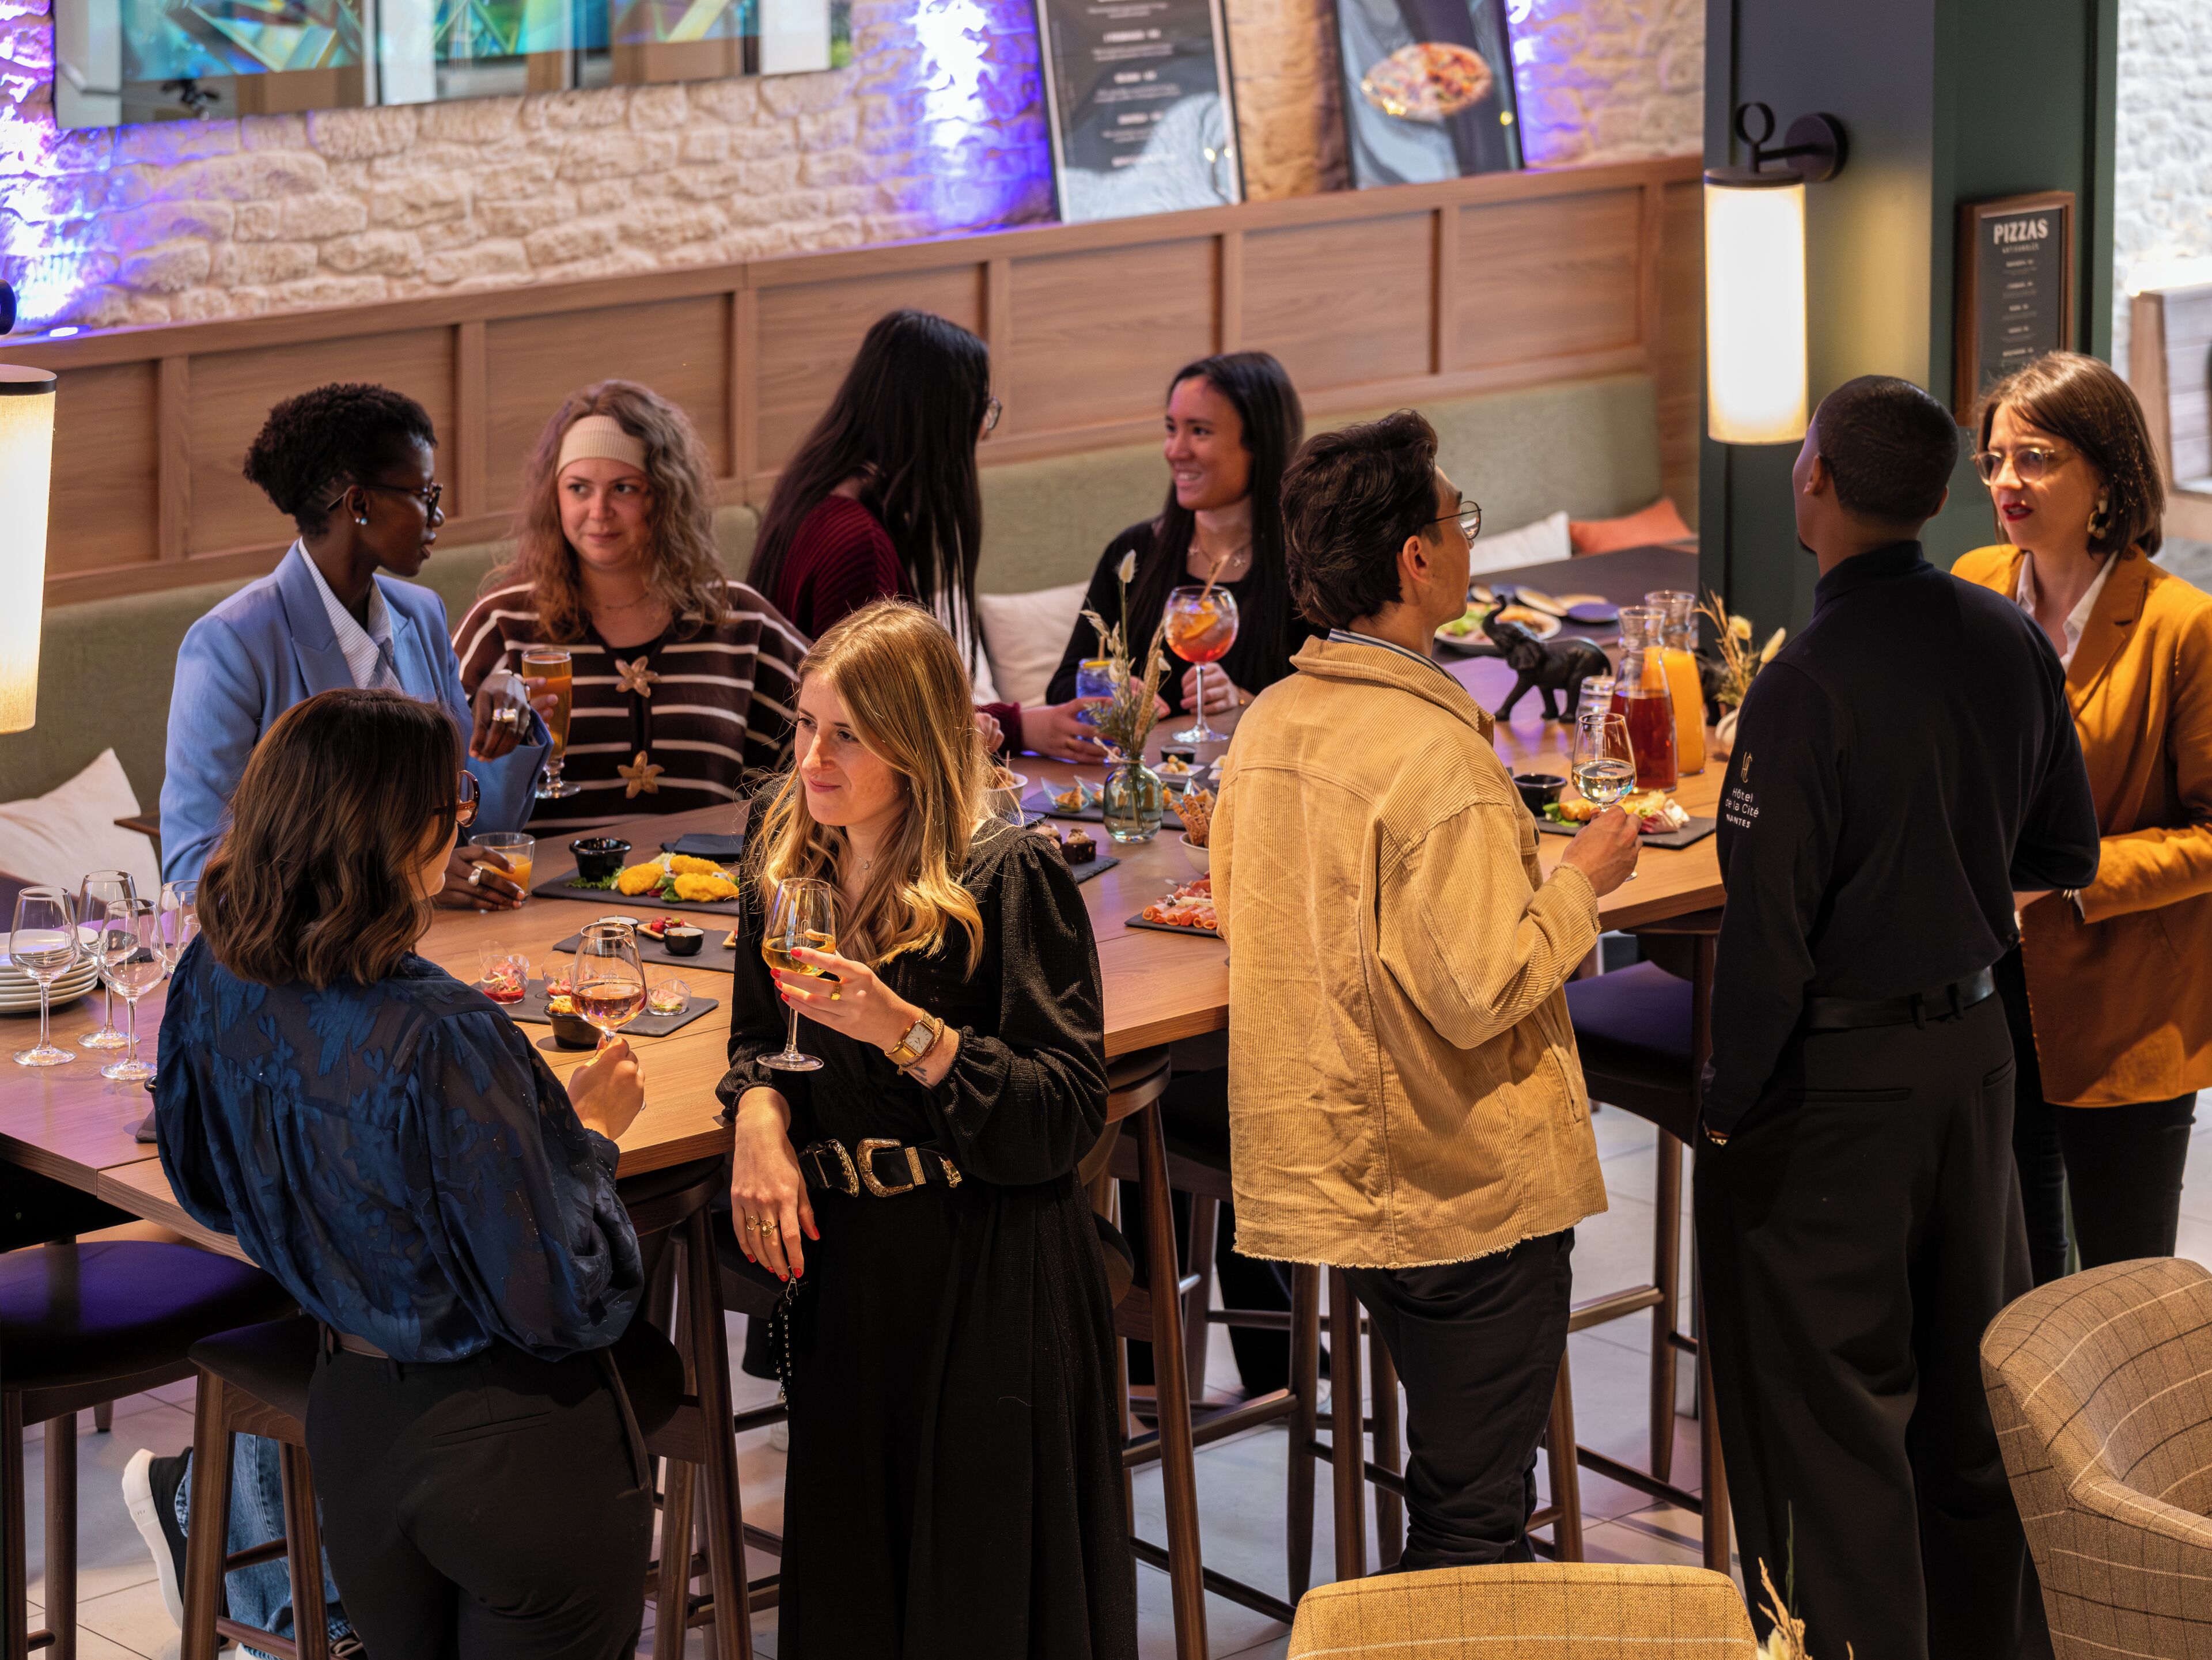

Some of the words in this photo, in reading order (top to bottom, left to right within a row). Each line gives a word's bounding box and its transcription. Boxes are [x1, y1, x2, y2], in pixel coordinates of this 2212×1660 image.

[1993, 218, 2048, 245] PIZZAS
[1732, 787, 1753, 803] Hôtel
[1733, 800, 1740, 811] la
[1742, 804, 1759, 817] Cité
[1726, 813, 1751, 828] NANTES
